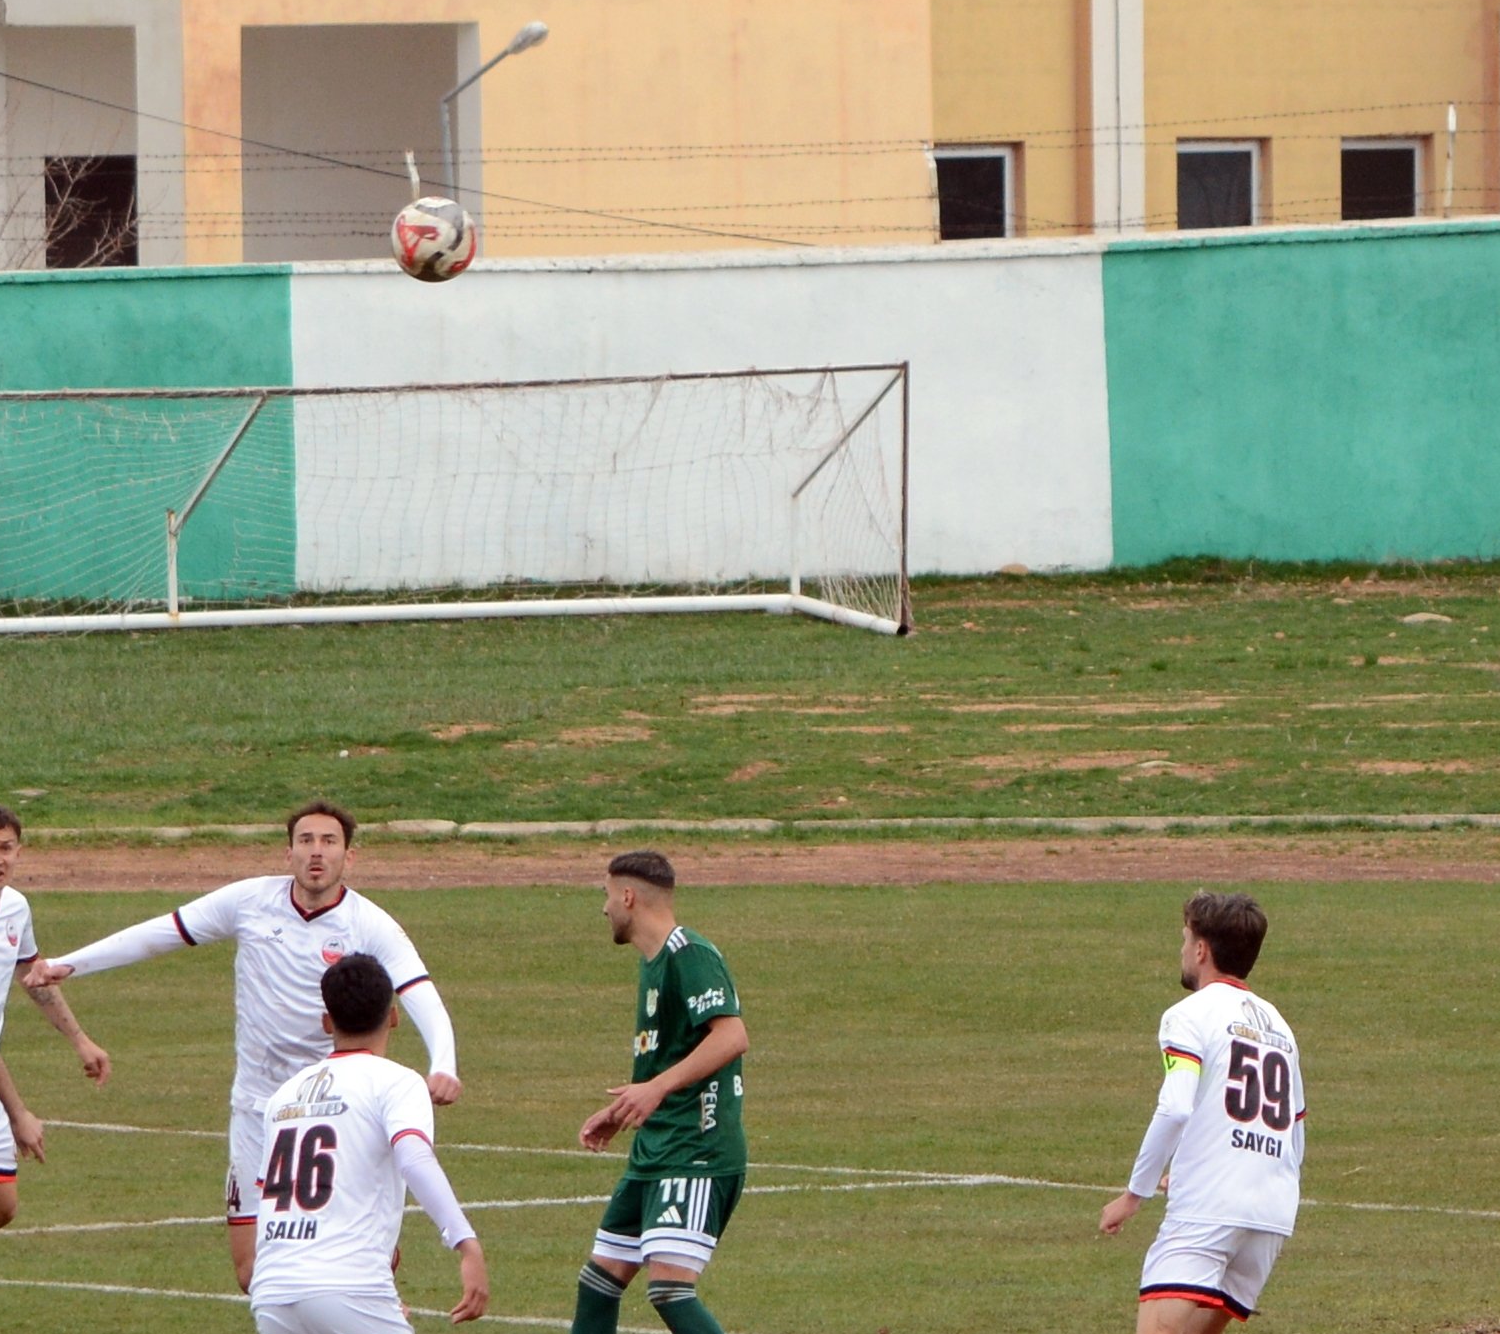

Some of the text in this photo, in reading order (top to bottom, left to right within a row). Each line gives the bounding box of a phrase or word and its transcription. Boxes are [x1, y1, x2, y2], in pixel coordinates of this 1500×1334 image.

[1224, 1038, 1291, 1132] 59
[262, 1123, 338, 1212] 46
[1231, 1128, 1283, 1159] SAYGI
[265, 1217, 318, 1241] SALİH
